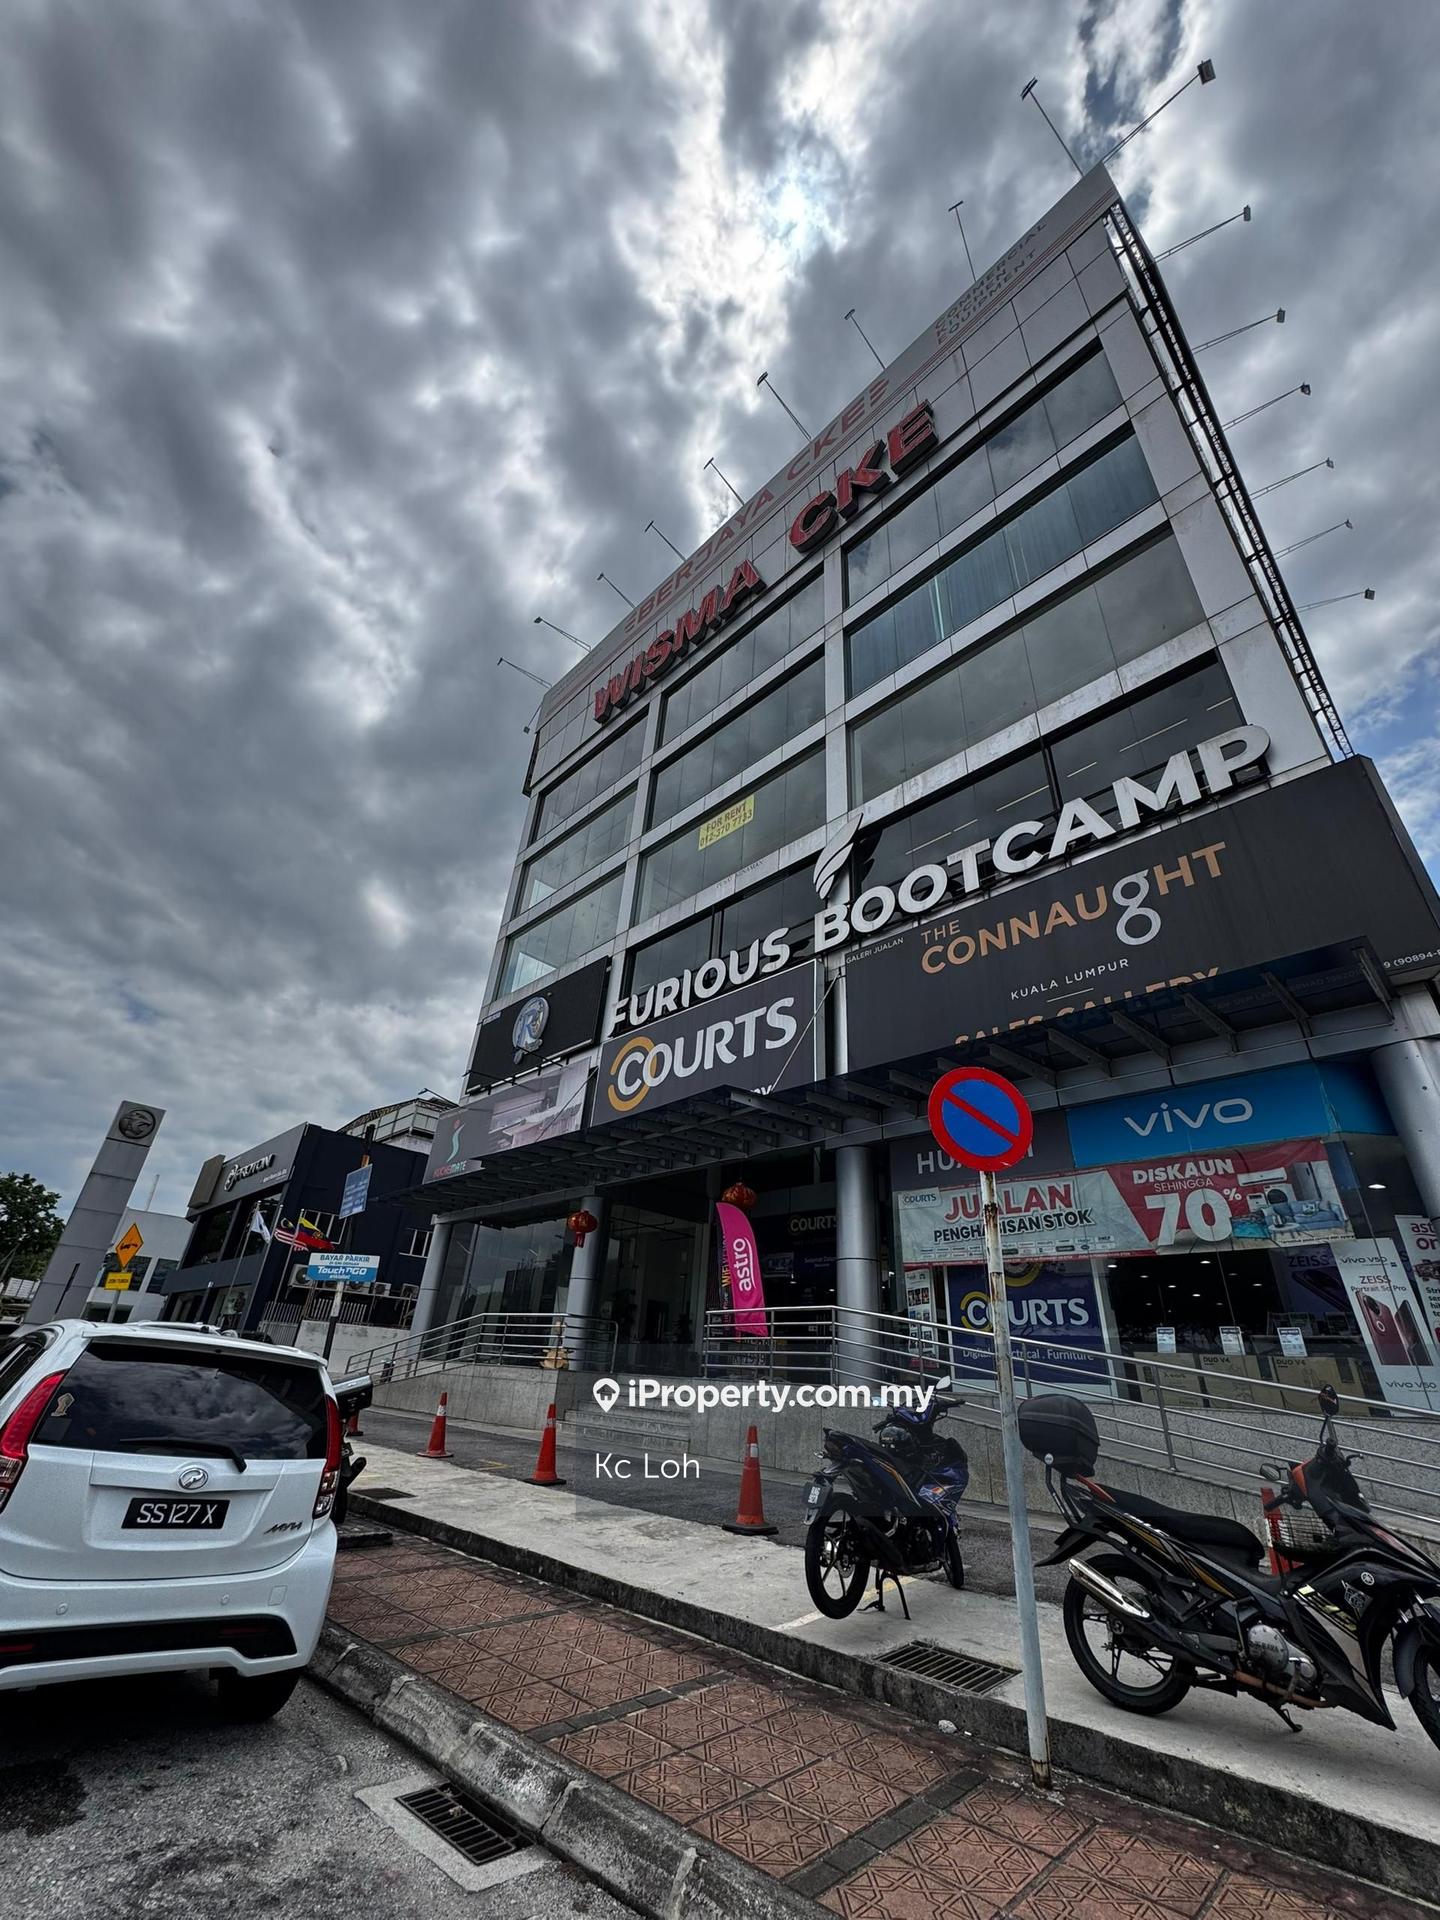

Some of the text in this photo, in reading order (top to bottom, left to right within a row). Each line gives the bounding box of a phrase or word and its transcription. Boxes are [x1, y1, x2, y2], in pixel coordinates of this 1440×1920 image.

[594, 399, 939, 724] WISMA CKE
[636, 488, 774, 623] BERJAYA
[706, 800, 747, 833] FOR RENT
[608, 723, 1271, 1037] FURIOUS BOOTCAMP
[920, 919, 961, 945] THE
[846, 937, 904, 964] GALERI JUALAN
[1010, 958, 1130, 1002] KUALA LUMPUR
[616, 996, 798, 1098] COURTS
[1124, 1098, 1253, 1137] vivo
[916, 1143, 1034, 1175] HUI
[1132, 1158, 1235, 1185] DISKAUN
[903, 1192, 938, 1206] COURTS
[1154, 1176, 1214, 1194] SEHINGGA
[934, 1208, 1092, 1243] PENGHISAN STOK
[320, 1254, 370, 1263] BAYAR PARKIR
[732, 1237, 753, 1292] astro
[1287, 1253, 1330, 1268] ZEISS
[1359, 1275, 1391, 1284] ZEISS
[1046, 1349, 1095, 1361] Furniture
